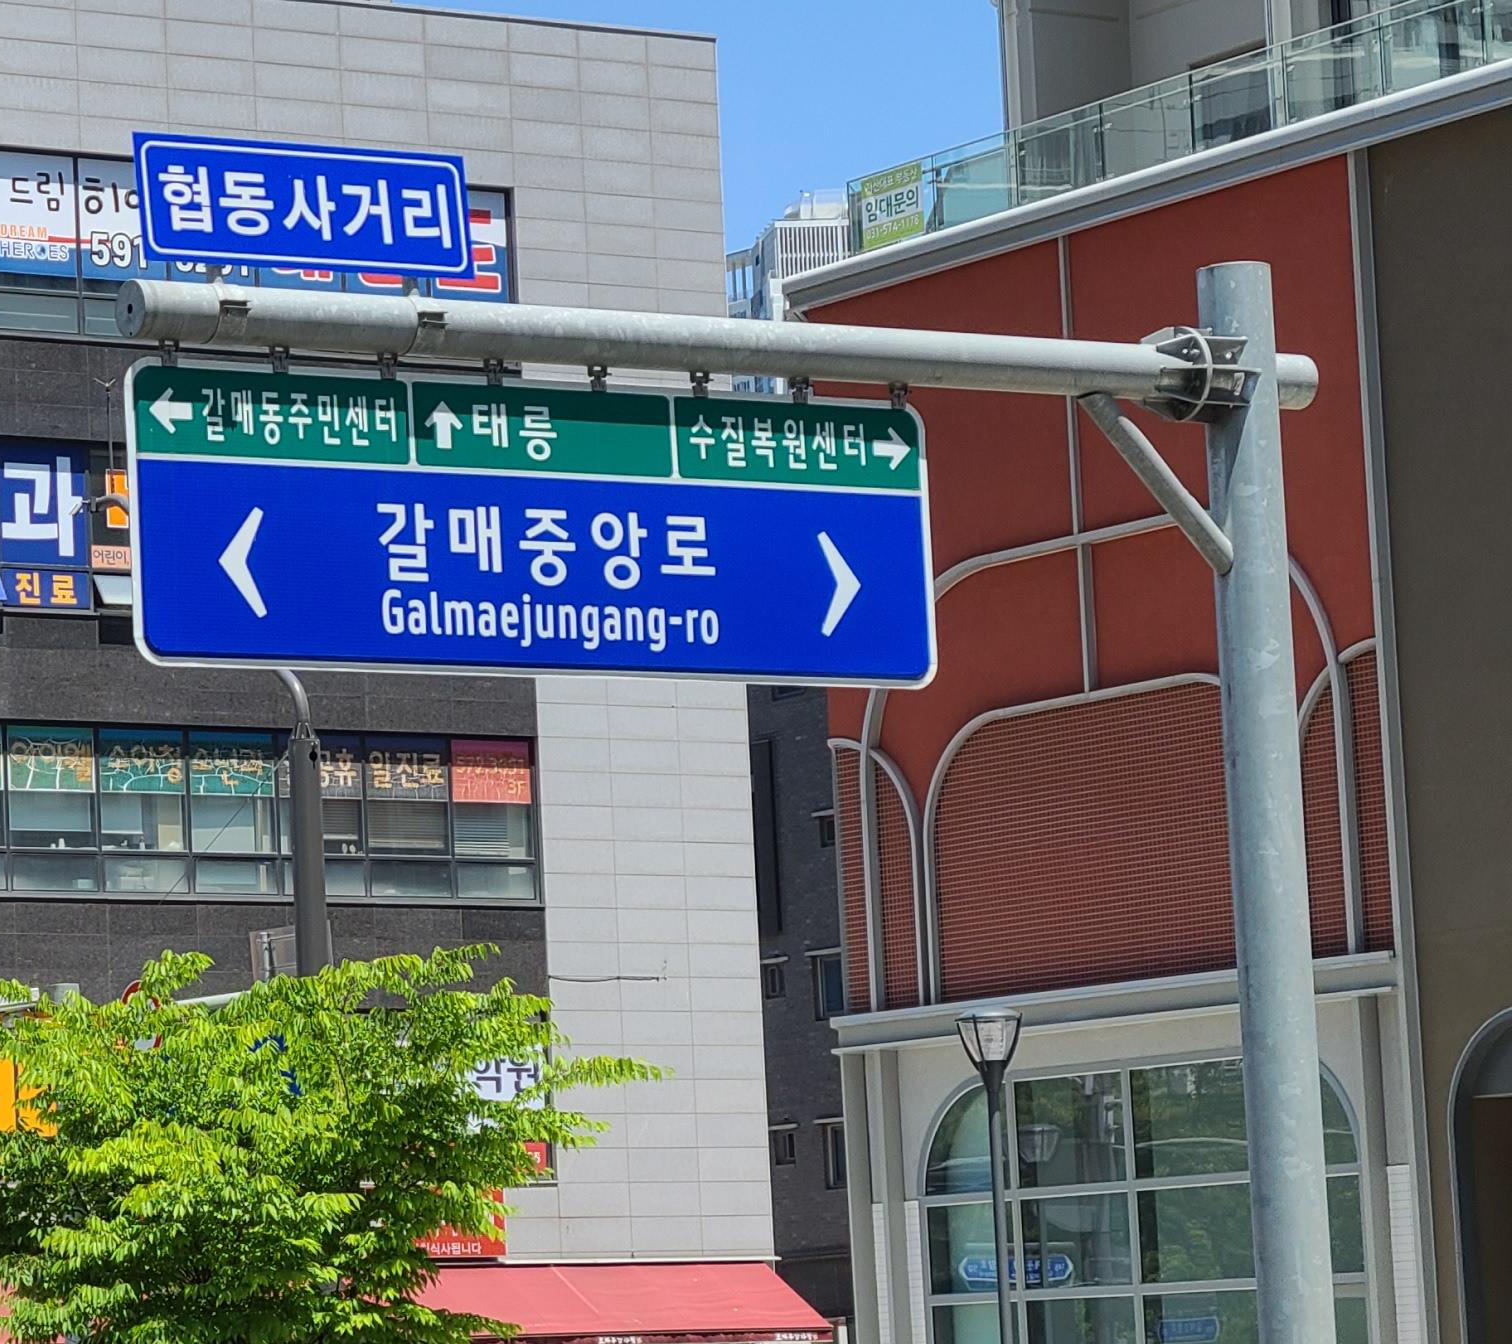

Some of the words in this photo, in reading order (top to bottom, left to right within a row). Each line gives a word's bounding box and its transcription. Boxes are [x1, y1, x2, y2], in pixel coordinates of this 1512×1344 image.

[10, 172, 65, 212] 드림
[158, 164, 454, 250] 협동사거리
[865, 185, 919, 223] 임대문의
[0, 223, 48, 240] DREAM
[201, 388, 397, 445] 갈매동주민센터
[473, 403, 558, 461] 태릉
[689, 415, 867, 471] 수질복원센터
[377, 502, 716, 591] 갈매중앙로
[15, 573, 78, 606] 진료
[381, 588, 720, 653] Galmaejungang-ro
